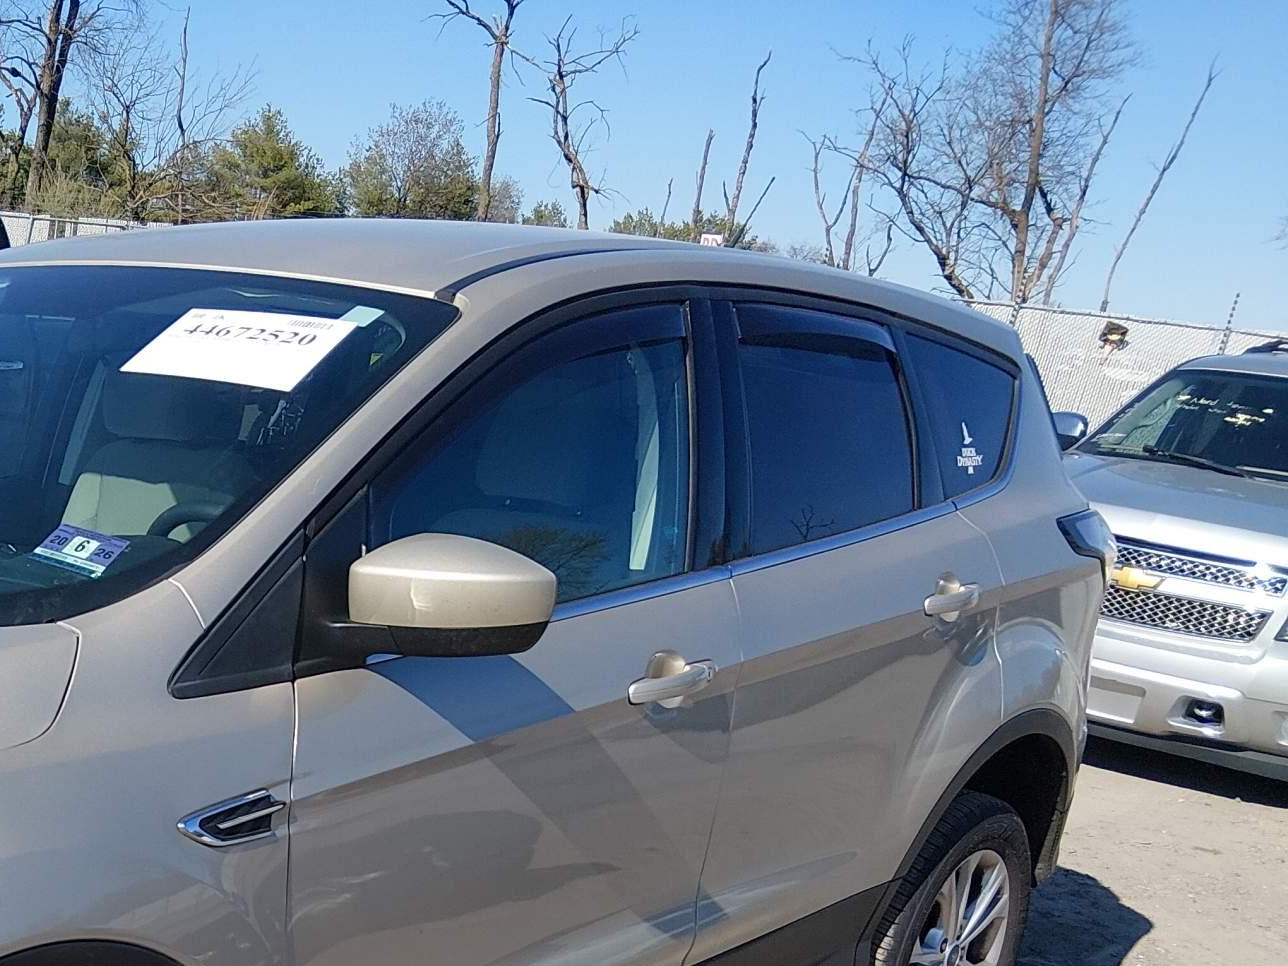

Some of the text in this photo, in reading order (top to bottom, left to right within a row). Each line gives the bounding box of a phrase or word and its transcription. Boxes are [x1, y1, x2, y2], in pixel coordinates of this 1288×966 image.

[184, 323, 318, 346] 44672520
[49, 534, 115, 560] 20 6 26
